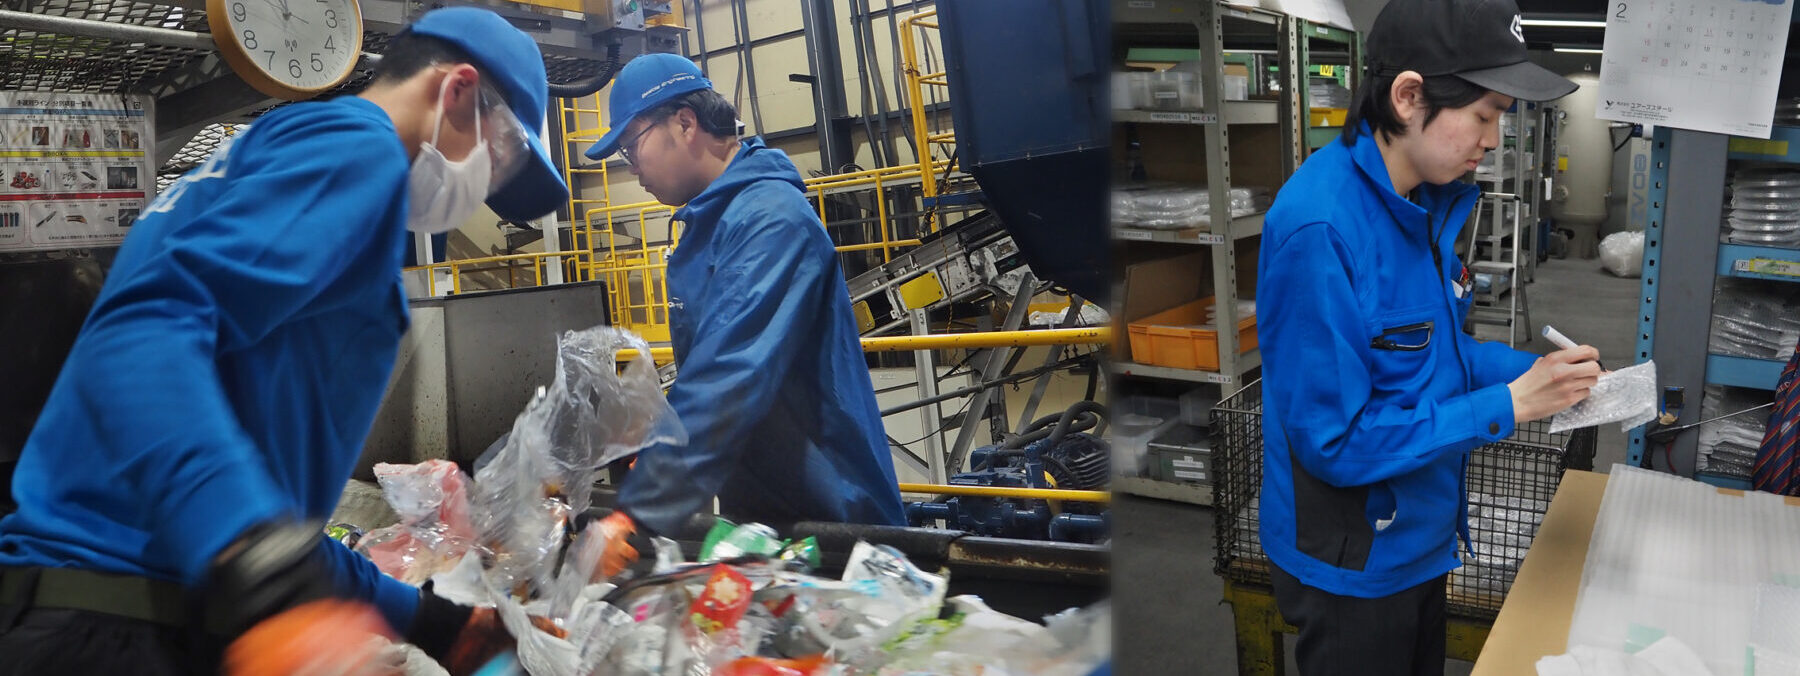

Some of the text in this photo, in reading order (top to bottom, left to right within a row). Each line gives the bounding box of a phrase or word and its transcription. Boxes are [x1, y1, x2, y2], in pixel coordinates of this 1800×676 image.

[232, 2, 246, 22] 9
[324, 9, 337, 28] 3
[1616, 3, 1626, 18] 2
[243, 30, 257, 50] 8
[324, 35, 336, 54] 4
[264, 50, 275, 70] 7
[288, 59, 302, 78] 6
[310, 53, 323, 72] 5
[1321, 66, 1331, 74] M
